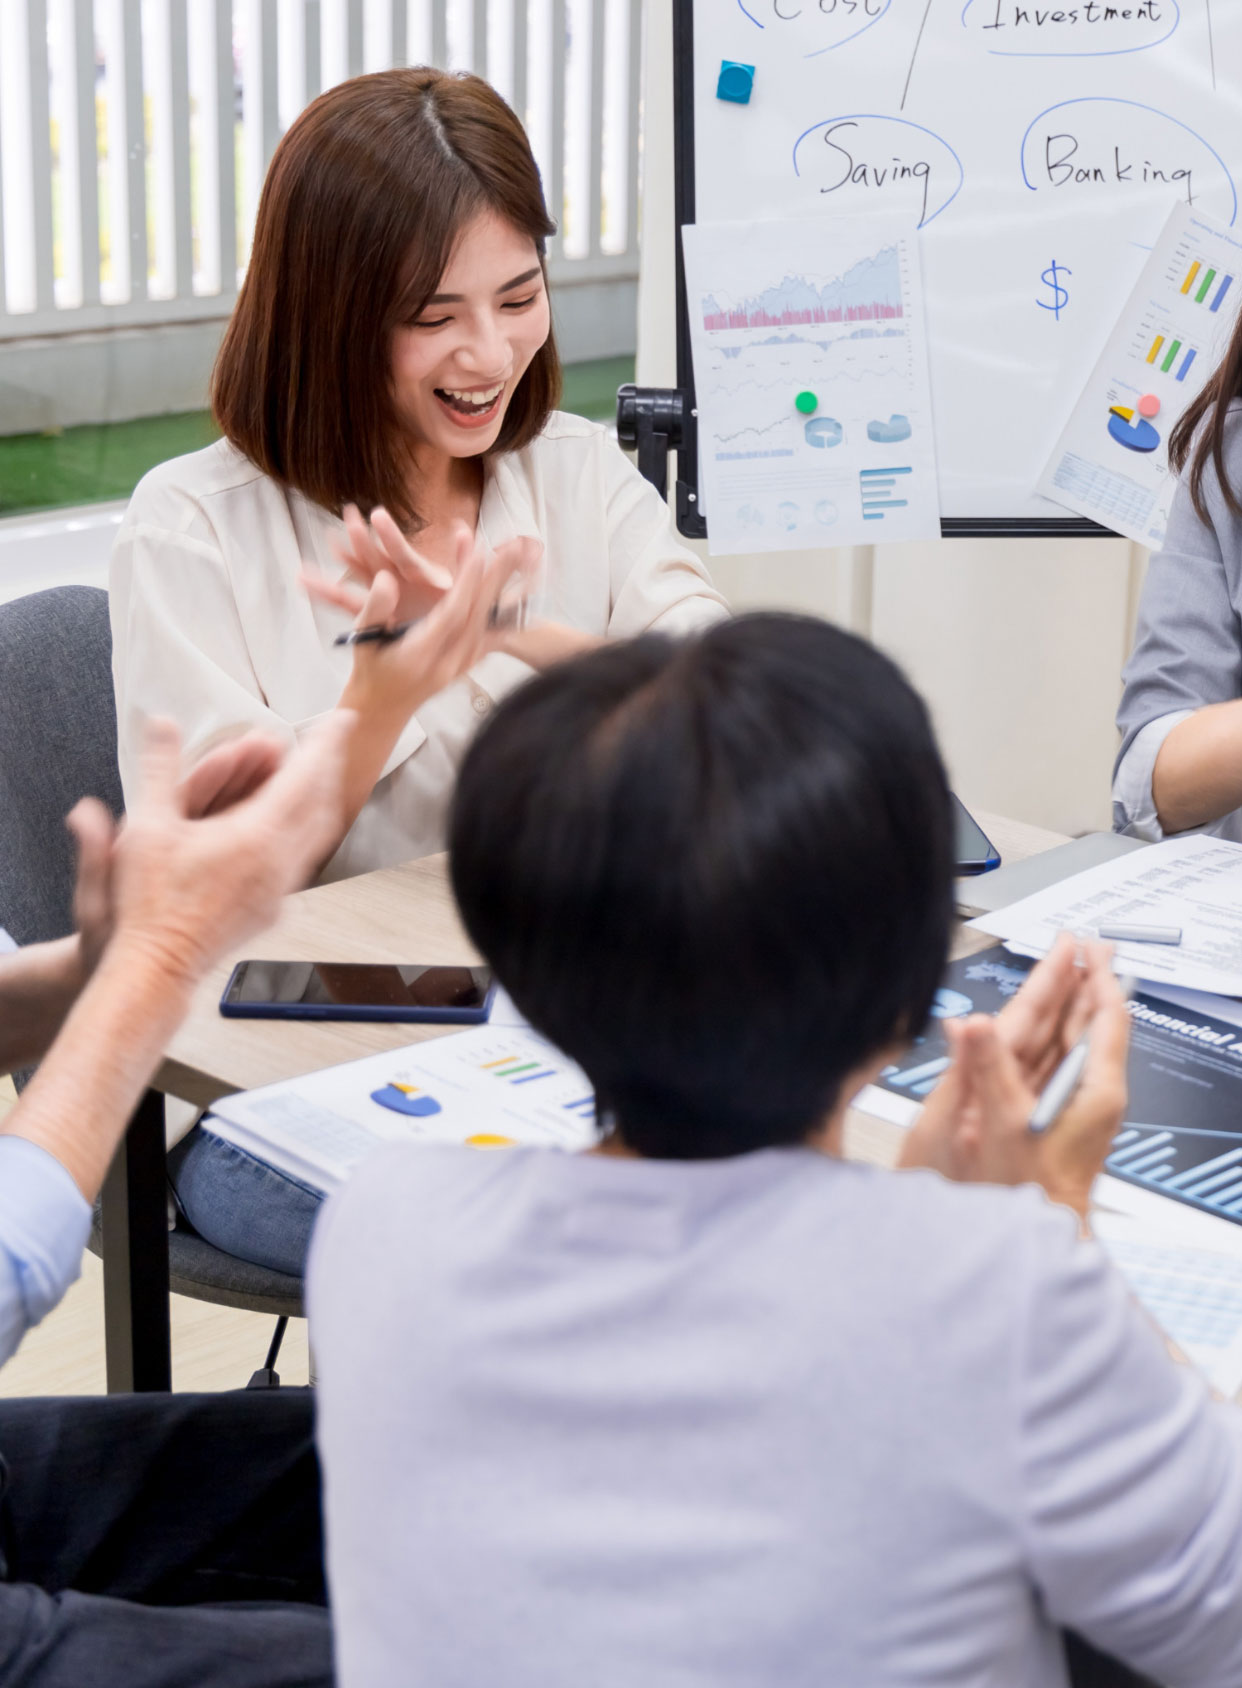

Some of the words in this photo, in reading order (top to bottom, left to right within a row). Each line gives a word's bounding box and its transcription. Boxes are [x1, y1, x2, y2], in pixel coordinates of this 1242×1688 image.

[982, 0, 1162, 30] Investment
[820, 122, 930, 230] Saving
[1045, 133, 1197, 206] Banking
[1035, 259, 1073, 322] $
[1123, 999, 1236, 1046] Financial
